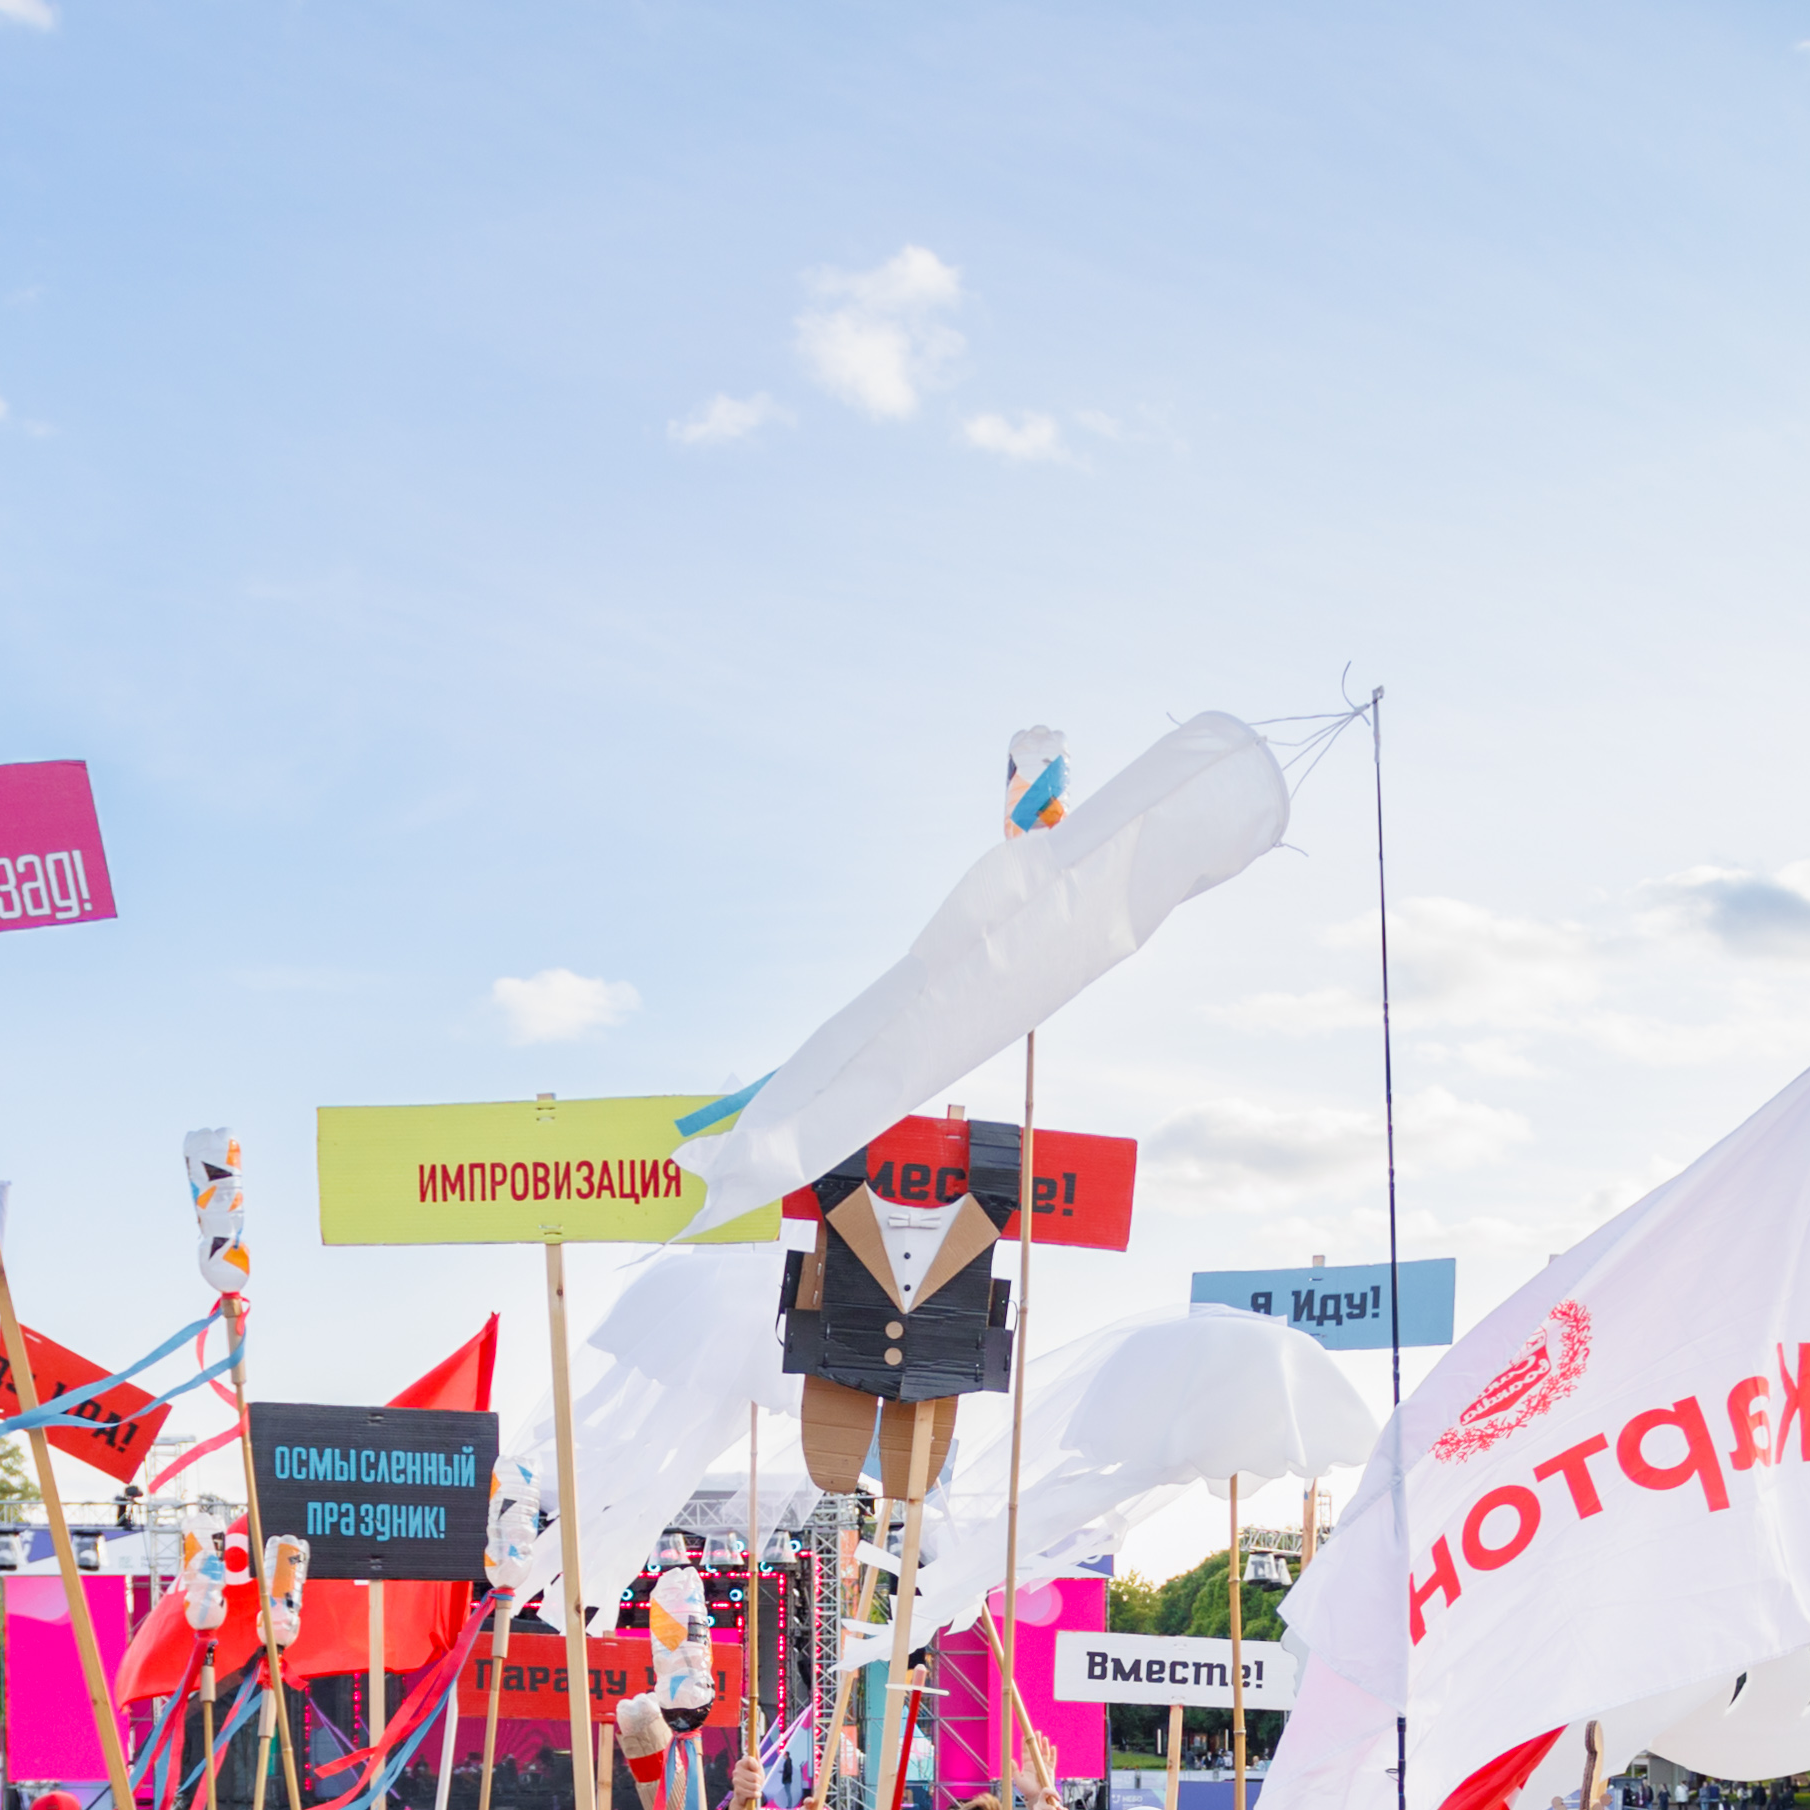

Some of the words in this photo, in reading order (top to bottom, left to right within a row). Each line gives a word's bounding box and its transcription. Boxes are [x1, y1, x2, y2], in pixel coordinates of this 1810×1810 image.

[418, 1158, 681, 1205] ИМПРОВИЗАЦИЯ
[869, 1161, 1077, 1217] месе!
[1291, 1286, 1382, 1327] Иду!
